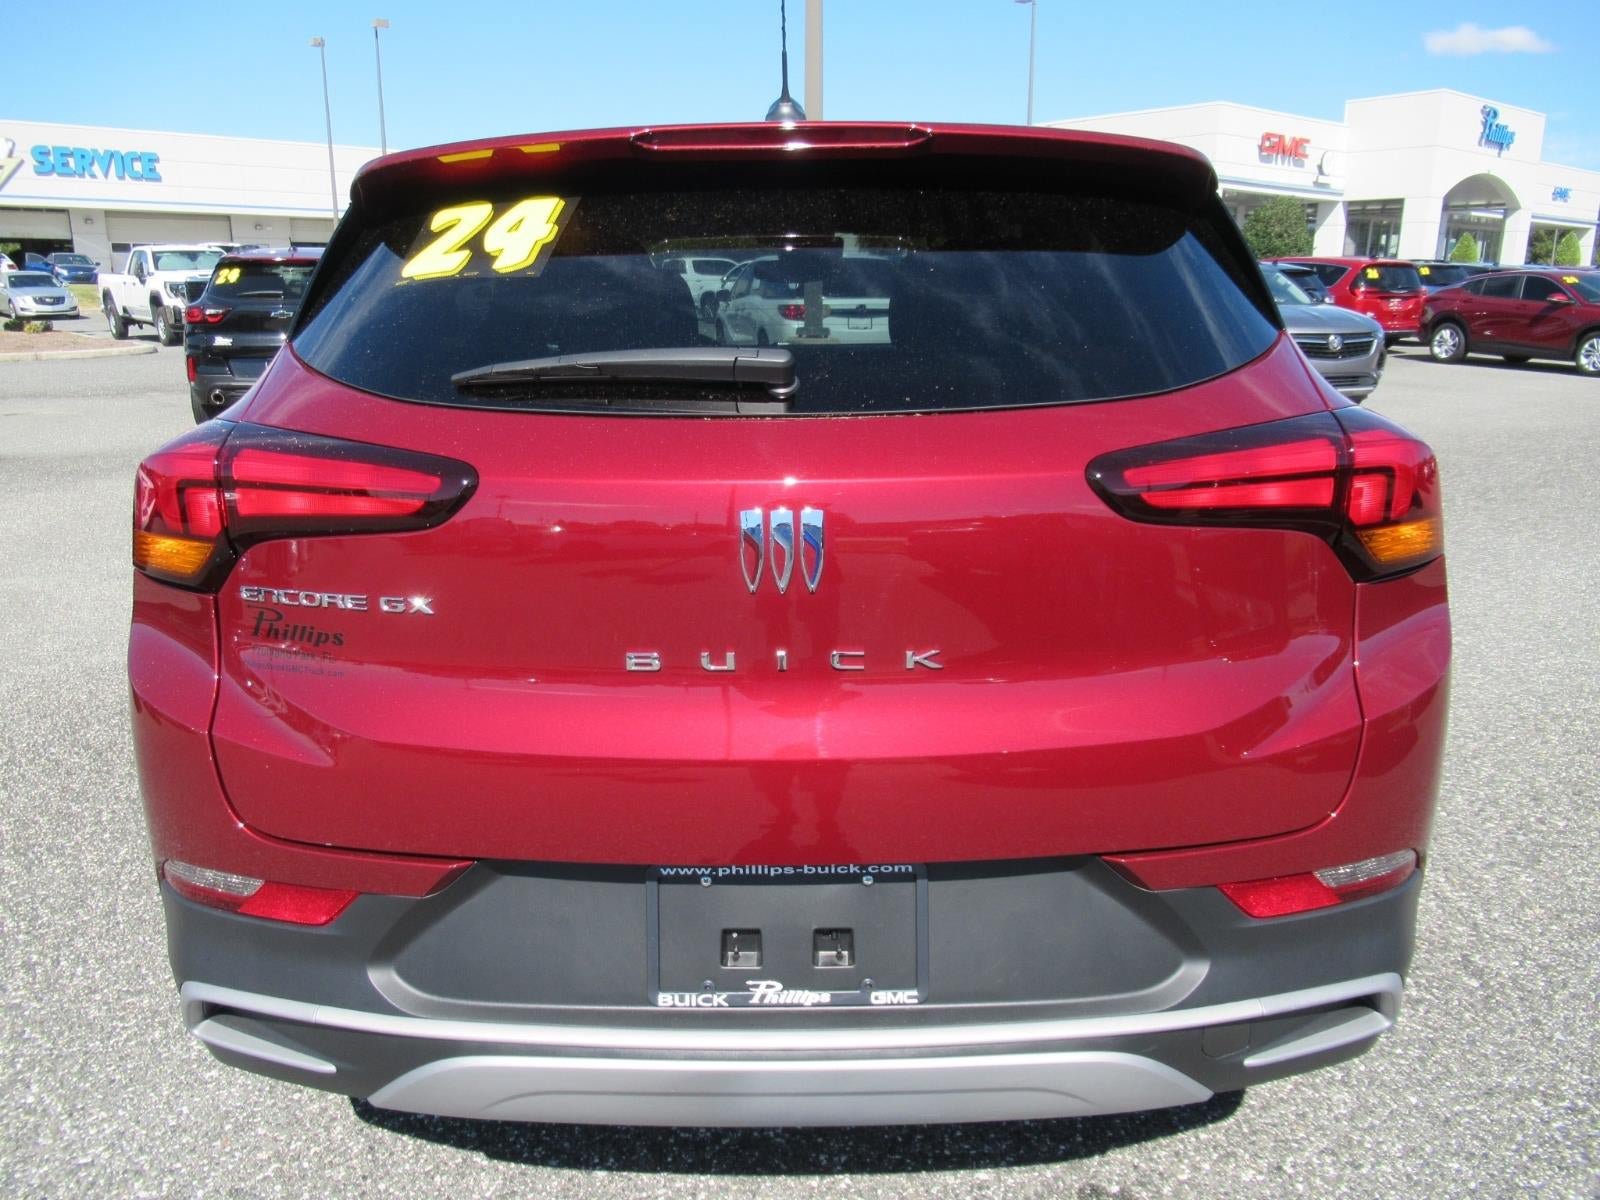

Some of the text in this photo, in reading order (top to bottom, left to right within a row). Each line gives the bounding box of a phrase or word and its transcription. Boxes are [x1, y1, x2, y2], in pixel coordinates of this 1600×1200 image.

[1480, 104, 1516, 146] Phillips
[1260, 131, 1311, 160] GMC
[31, 145, 162, 181] SERVICE
[401, 196, 566, 281] 24
[239, 585, 435, 615] ENCORE GX
[247, 604, 345, 647] Phillips
[626, 649, 945, 672] BUICK
[659, 863, 914, 877] www.phillips-buick.com
[657, 980, 919, 1007] BUICK Phillips GMC
